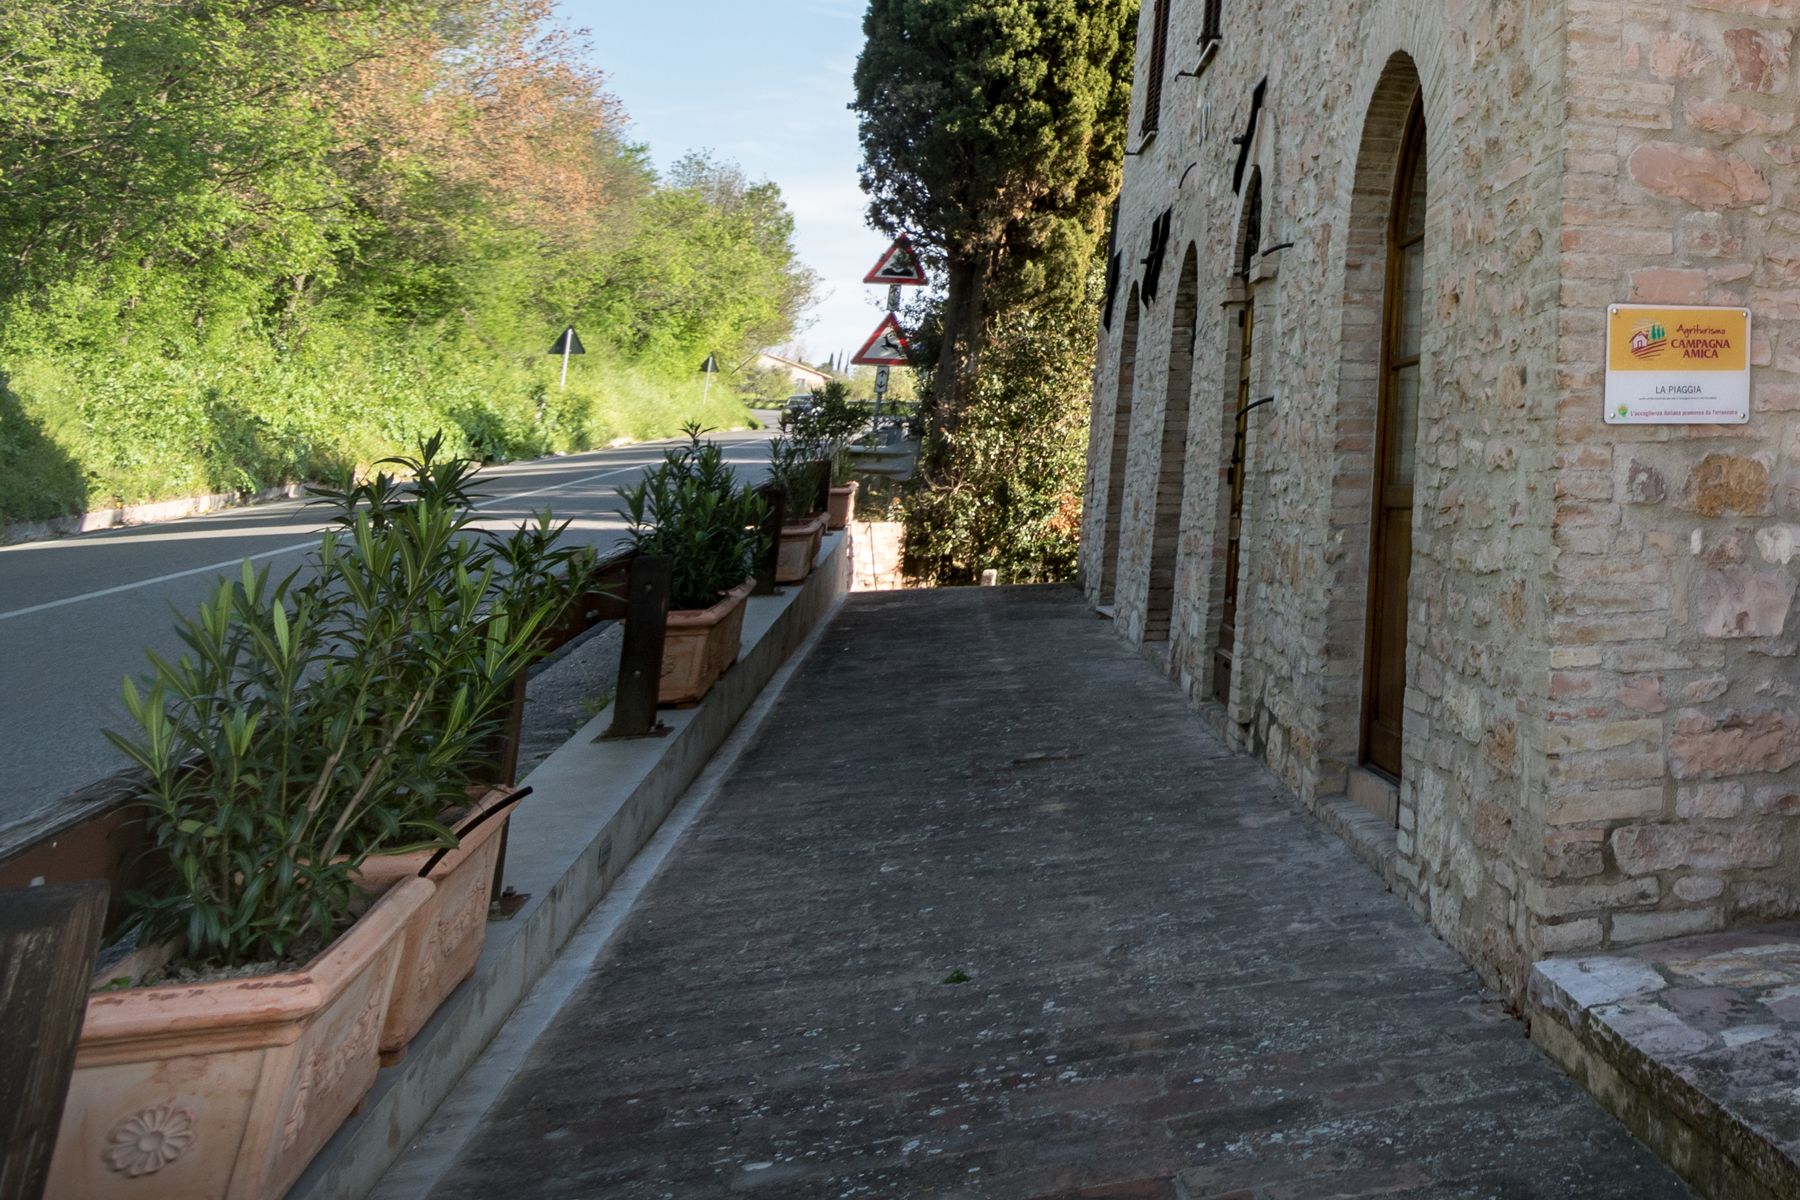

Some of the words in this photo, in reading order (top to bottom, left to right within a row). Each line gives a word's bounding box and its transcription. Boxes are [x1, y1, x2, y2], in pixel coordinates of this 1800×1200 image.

[1676, 324, 1726, 338] Agriturismo
[1671, 339, 1730, 349] CAMPAGNA
[1683, 349, 1719, 358] AMICA
[1655, 386, 1666, 394] LA
[1668, 385, 1702, 394] PIAGGIA
